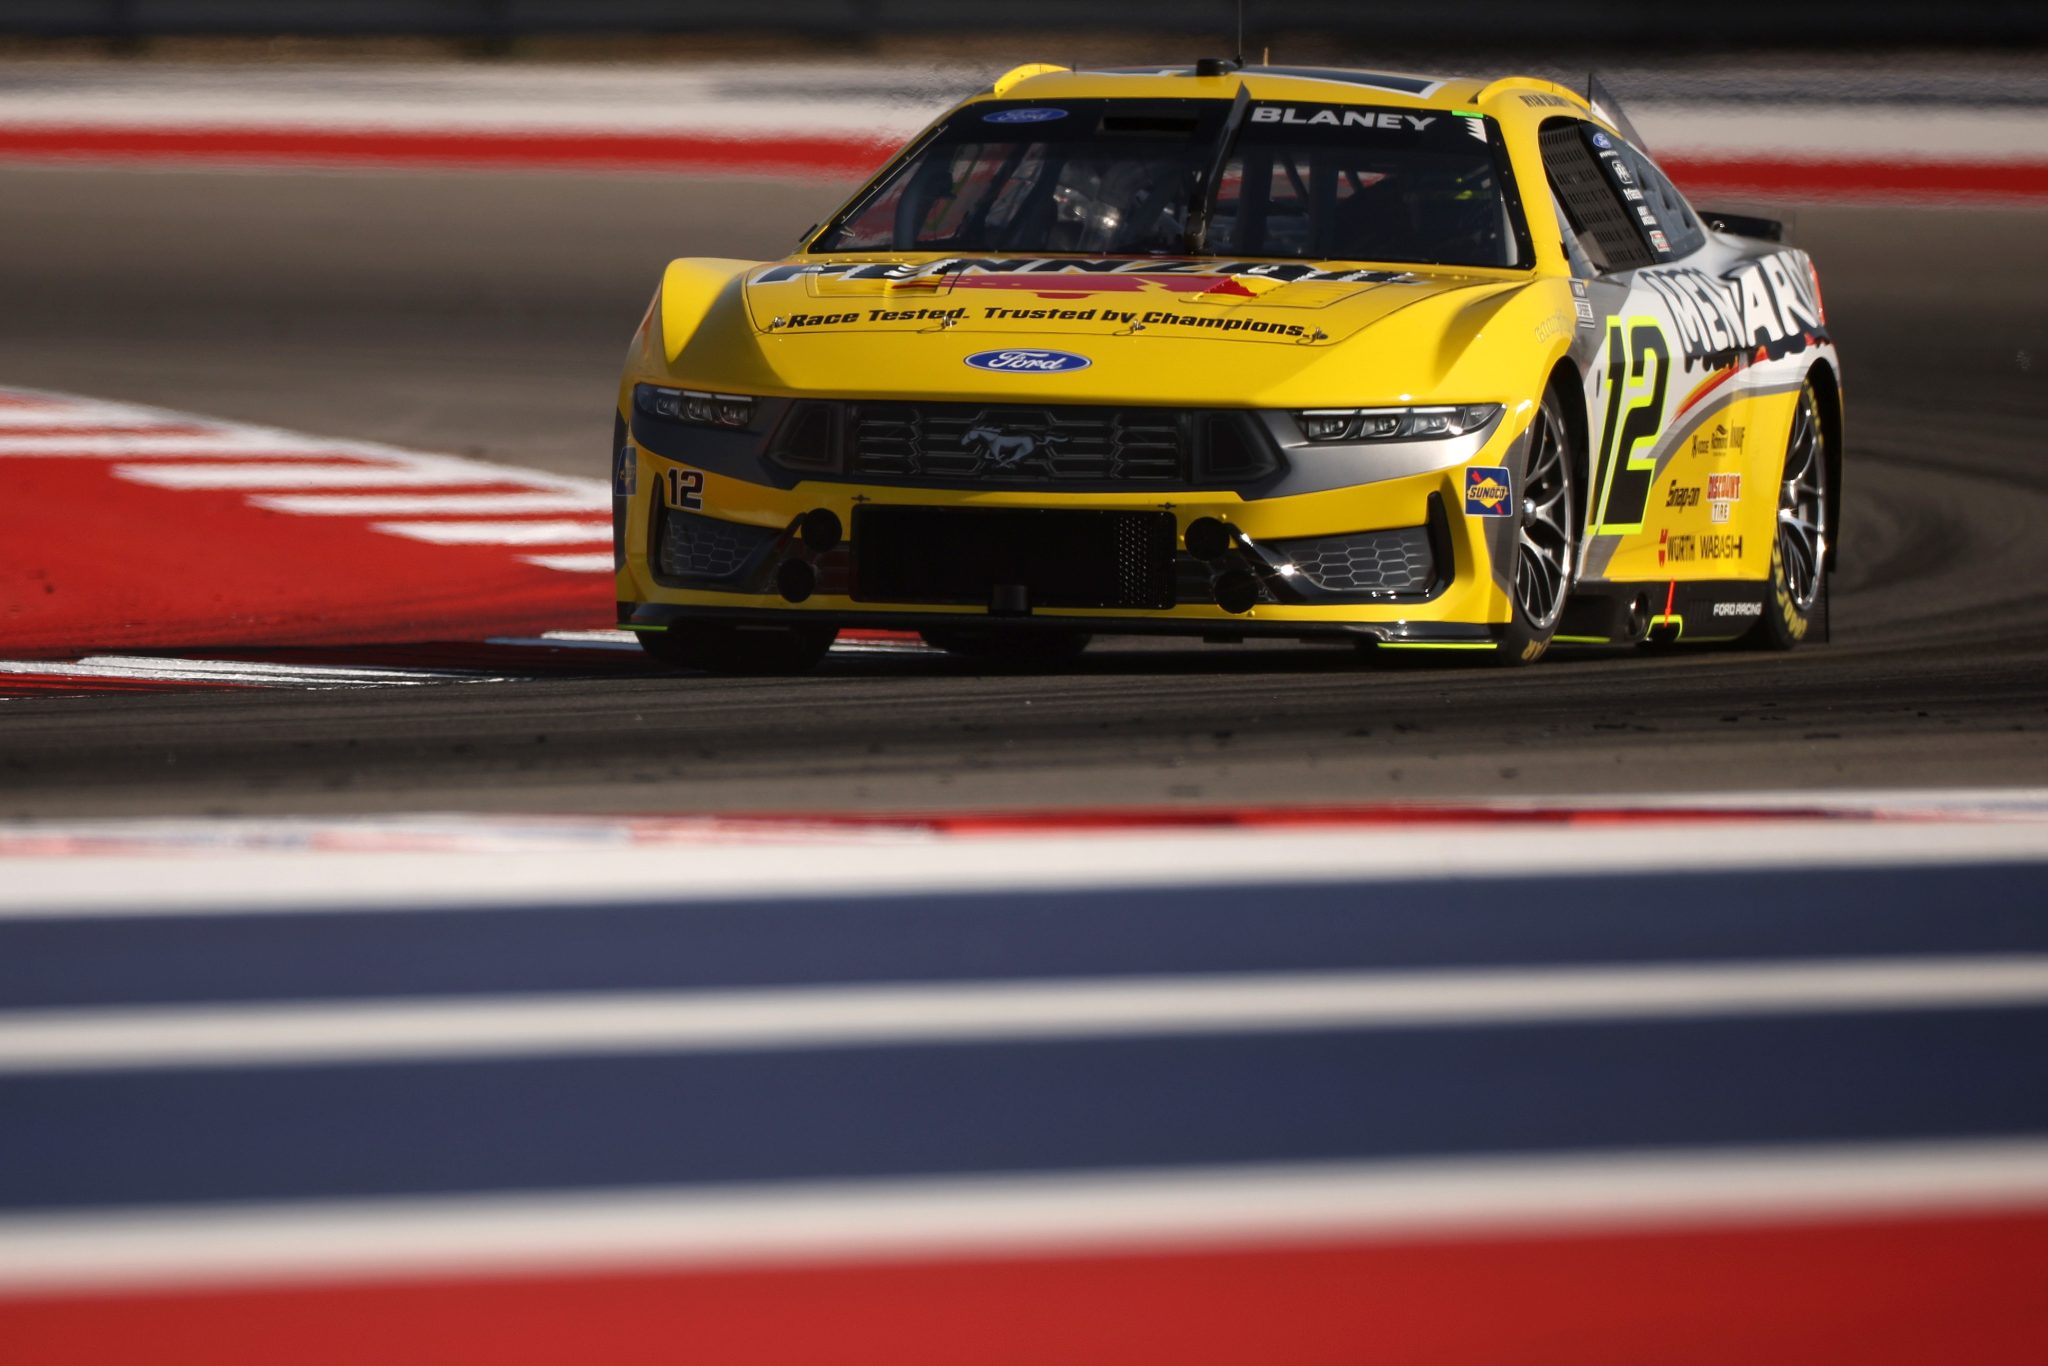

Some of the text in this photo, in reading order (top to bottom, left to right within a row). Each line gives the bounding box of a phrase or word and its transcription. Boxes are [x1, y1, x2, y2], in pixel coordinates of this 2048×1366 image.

[1251, 107, 1436, 131] BLANEY
[787, 307, 1310, 338] Race Tested. Trusted by Champions.
[988, 351, 1067, 370] Ford
[1587, 316, 1671, 535] 12
[668, 467, 704, 511] 12
[1469, 487, 1506, 499] SUNOCO
[1665, 480, 1700, 514] Snap-on
[1707, 475, 1740, 499] DISCOUNT
[1713, 504, 1728, 519] TIRE
[1700, 535, 1742, 559] WABASH
[1713, 602, 1762, 616] FORD RACING
